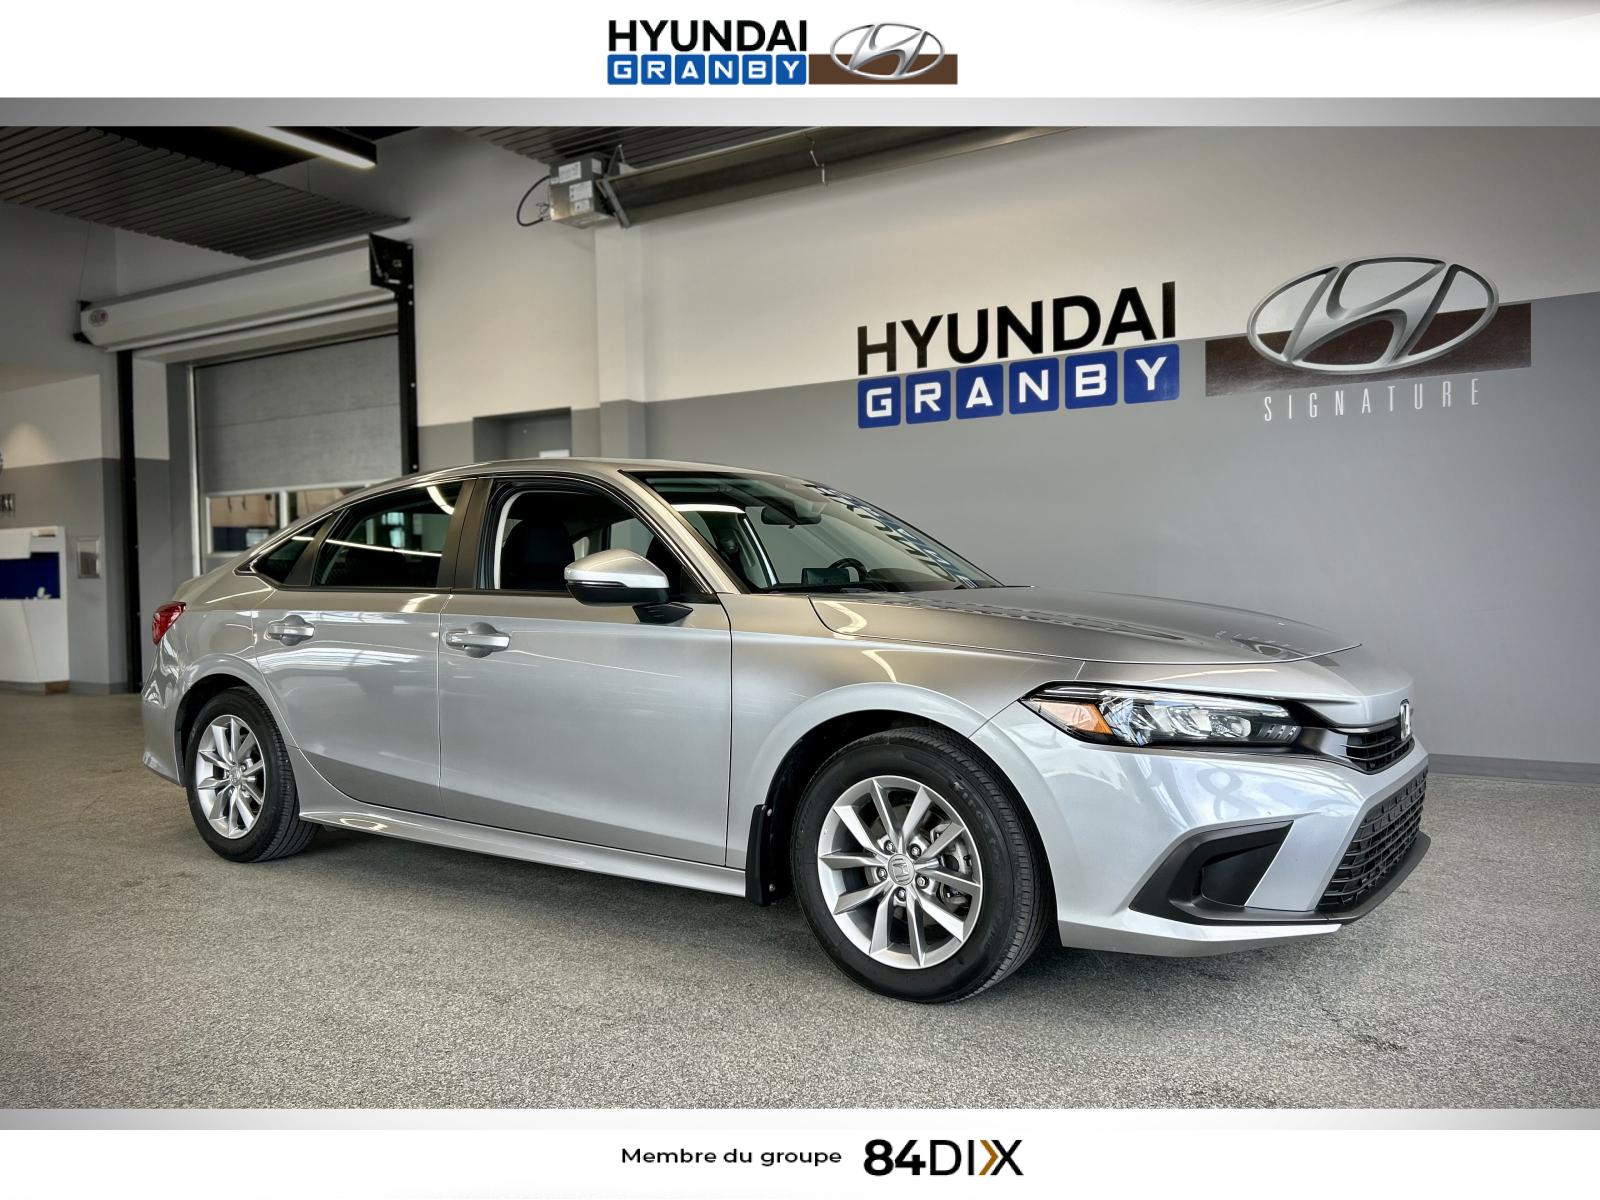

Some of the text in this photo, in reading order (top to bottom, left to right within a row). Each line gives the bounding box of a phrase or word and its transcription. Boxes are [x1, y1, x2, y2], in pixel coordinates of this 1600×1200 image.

[857, 281, 1176, 376] HYUNDAI
[866, 356, 1167, 418] GRANBY
[1264, 378, 1479, 422] SIGNATURE
